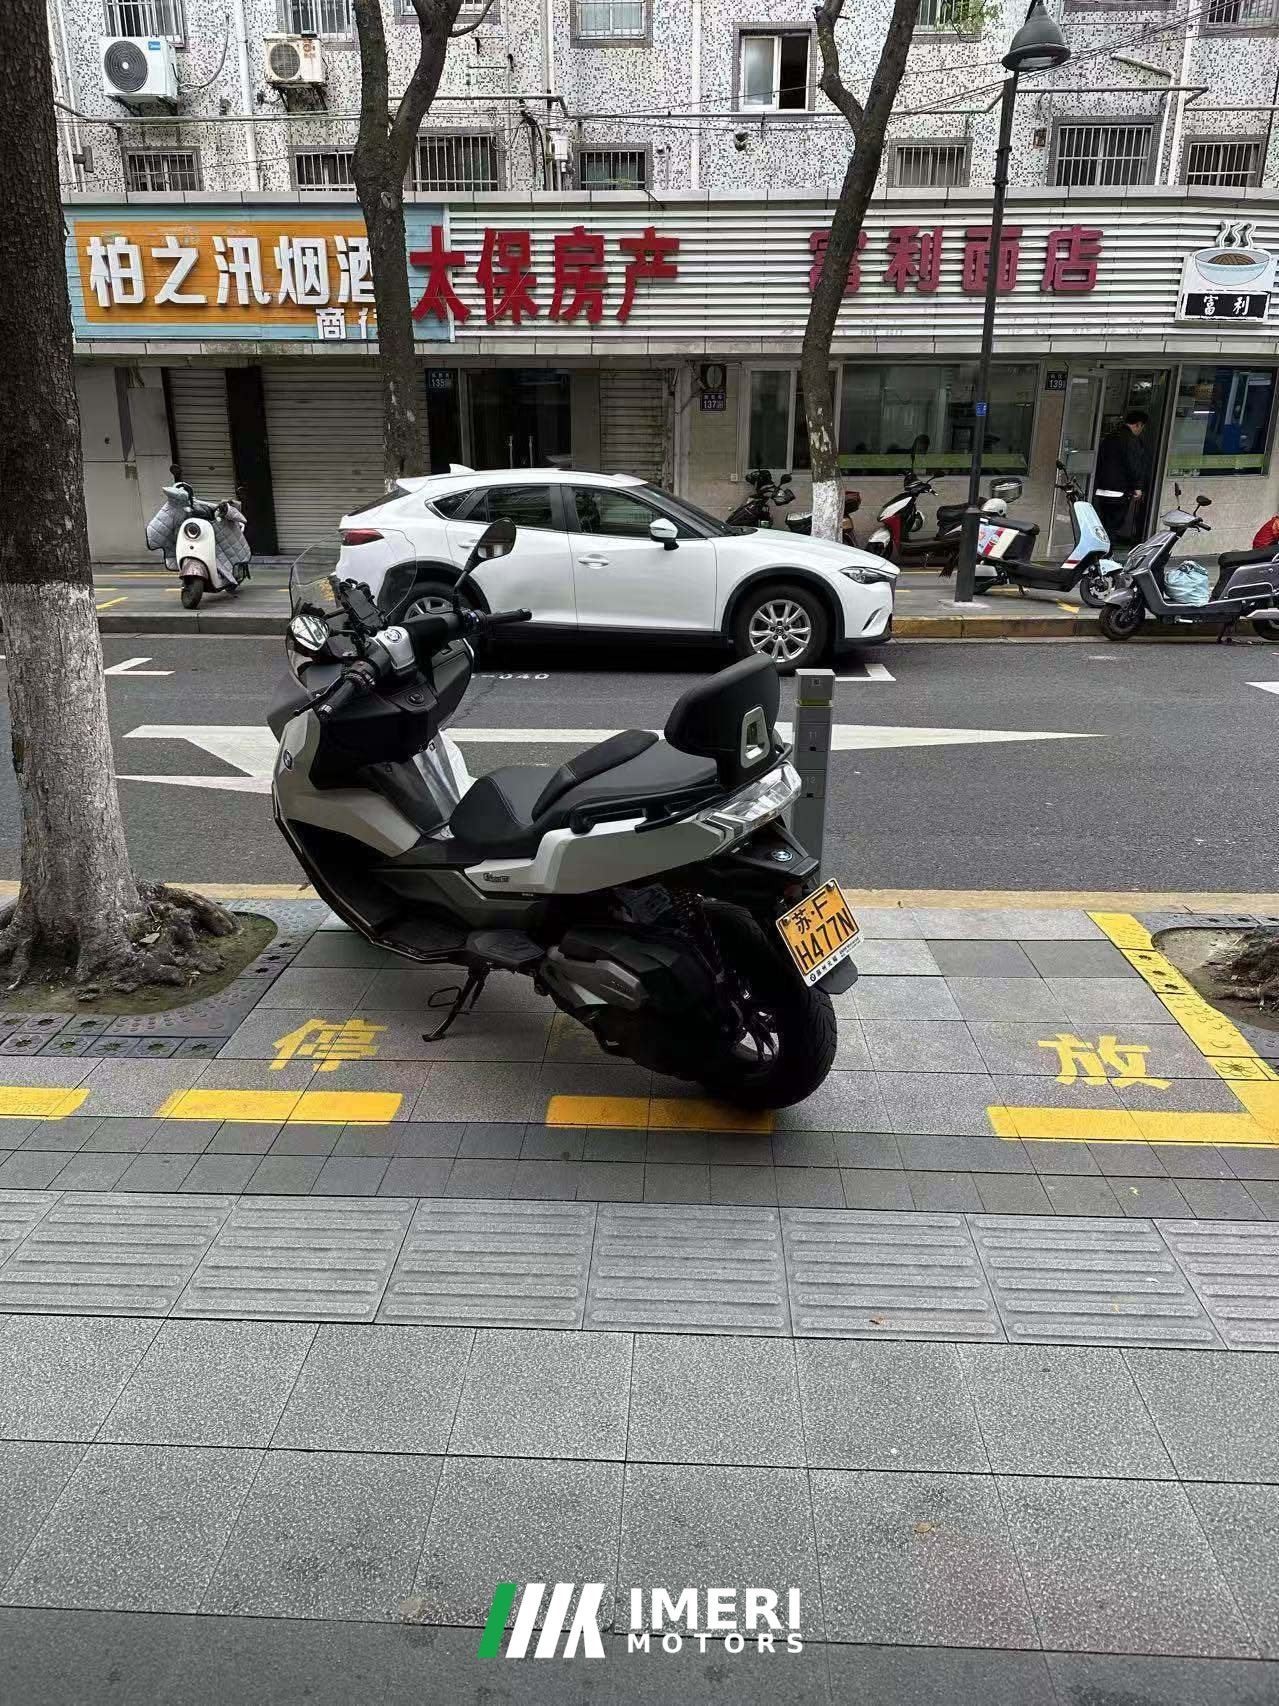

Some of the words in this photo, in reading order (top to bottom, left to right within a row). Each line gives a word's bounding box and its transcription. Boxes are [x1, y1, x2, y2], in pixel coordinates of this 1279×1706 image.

[410, 225, 681, 325] 太保房产
[1204, 295, 1250, 316] 富利
[794, 908, 855, 971] H477N
[268, 1018, 389, 1072] 停
[1038, 1033, 1173, 1090] 放
